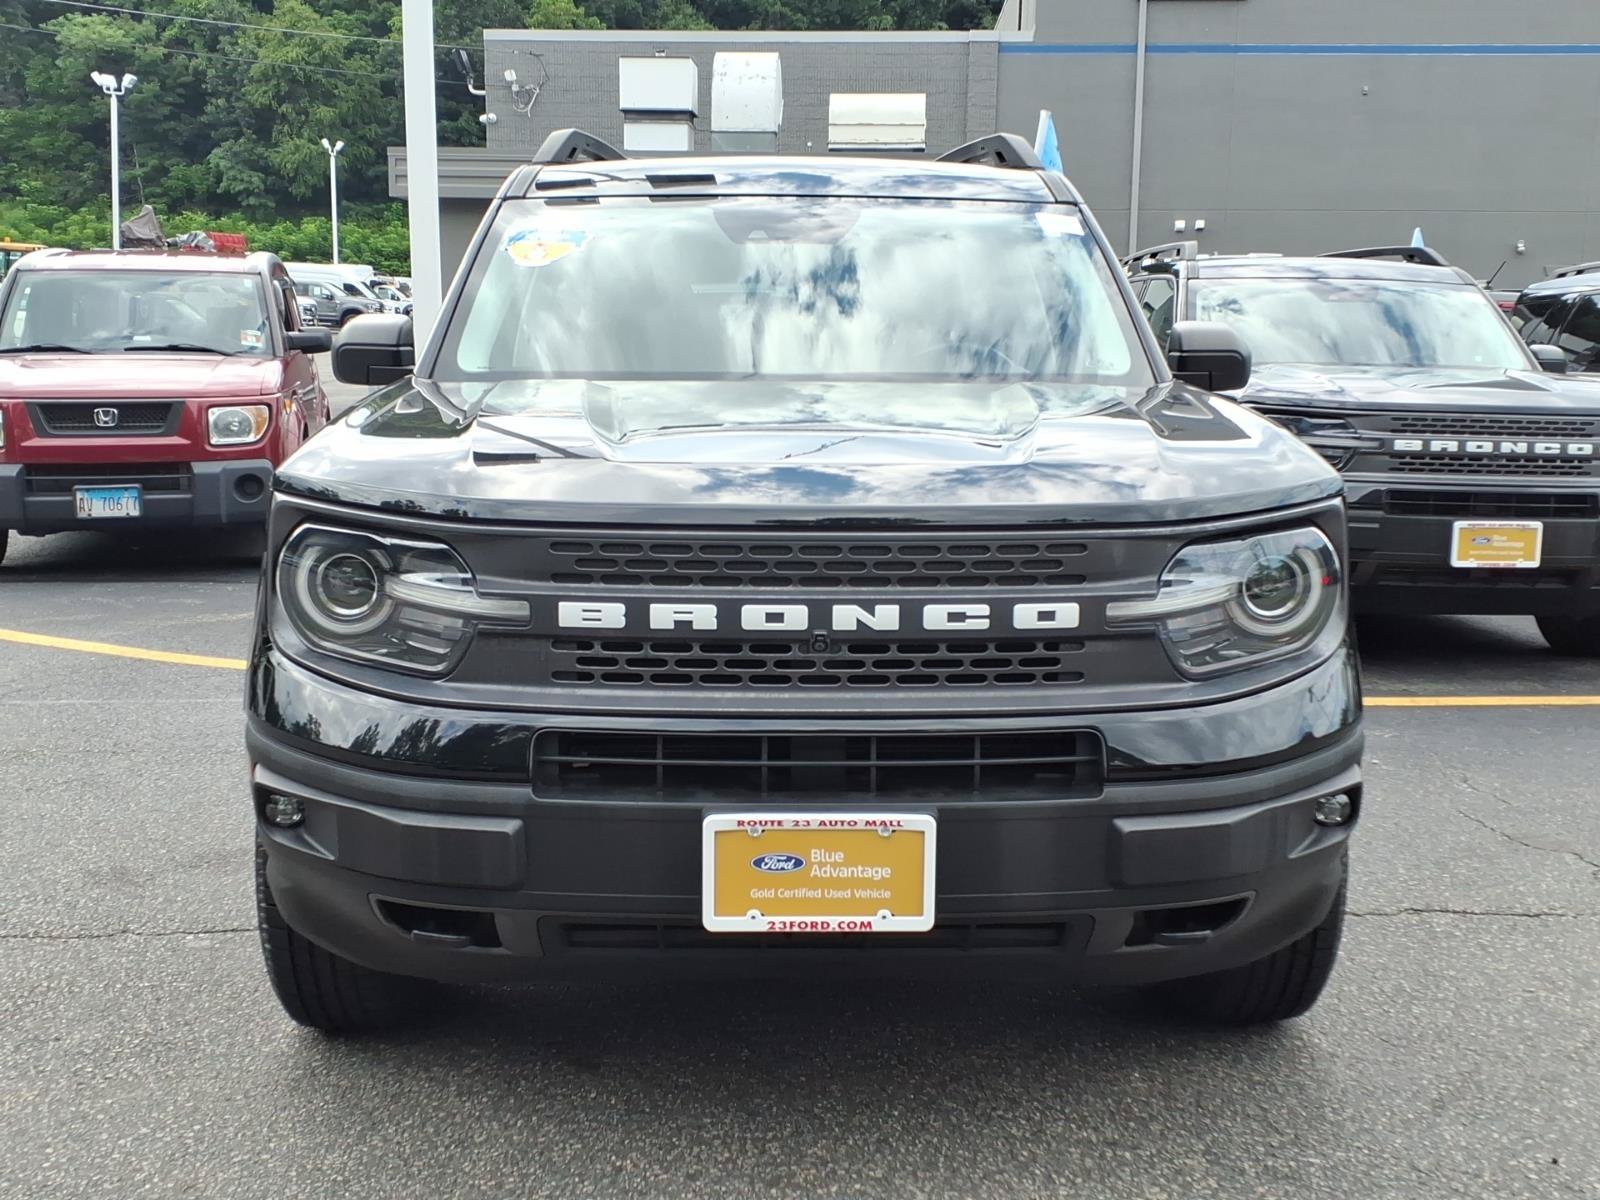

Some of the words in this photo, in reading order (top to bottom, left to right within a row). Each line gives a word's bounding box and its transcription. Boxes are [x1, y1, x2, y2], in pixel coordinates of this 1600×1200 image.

[1393, 439, 1593, 455] BRONCO
[79, 497, 93, 512] AV
[100, 496, 138, 511] 70677
[558, 602, 1080, 631] BRONCO
[864, 820, 904, 828] MALL
[761, 855, 796, 871] Ford
[810, 849, 844, 862] Blue
[810, 864, 891, 880] Advantage
[750, 888, 775, 898] Gold
[777, 887, 822, 899] Certified
[824, 888, 851, 898] Used
[854, 887, 891, 899] Vehicle
[766, 921, 873, 931] 23FORD.COM
